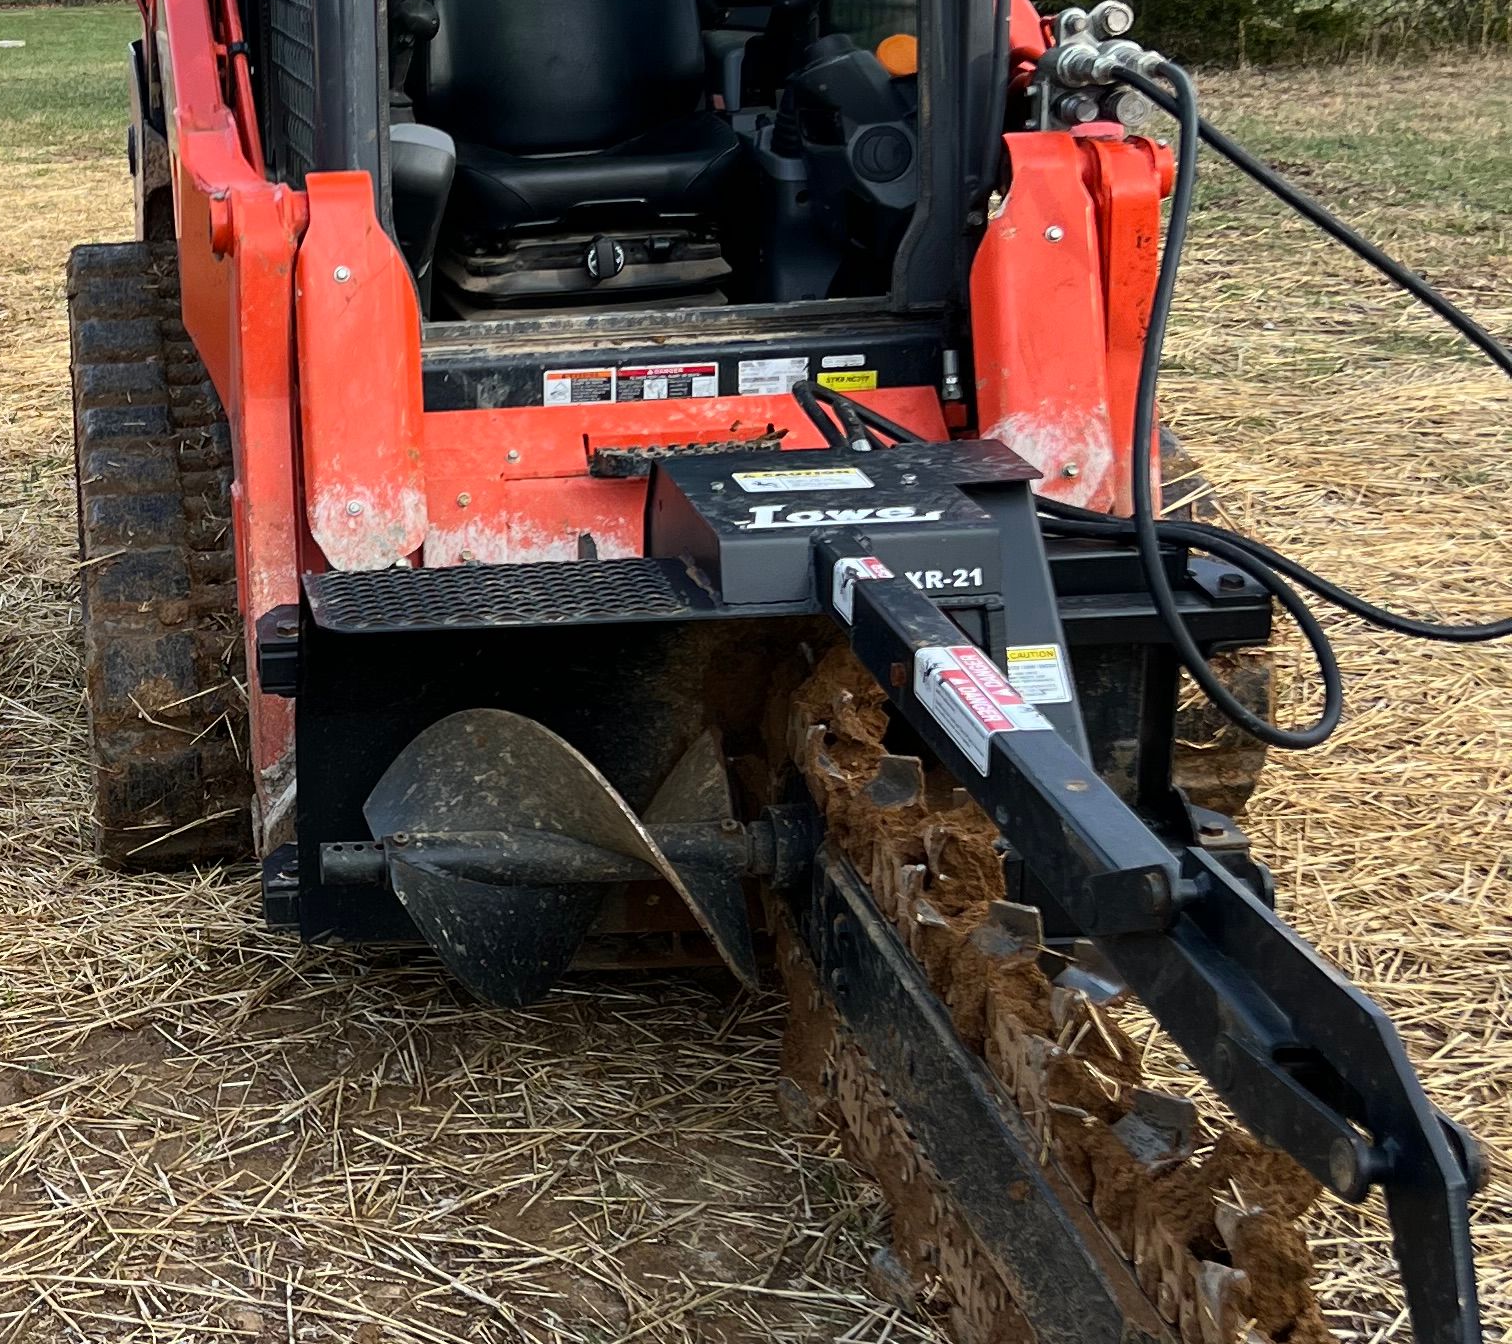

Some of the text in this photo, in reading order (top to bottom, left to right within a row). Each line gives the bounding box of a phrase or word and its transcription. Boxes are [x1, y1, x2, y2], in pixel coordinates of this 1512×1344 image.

[763, 469, 851, 477] CAUTION
[904, 567, 983, 590] XR-21
[1009, 650, 1054, 660] CAUTION
[959, 654, 1004, 688] DANGER
[957, 686, 1005, 722] DANGER
